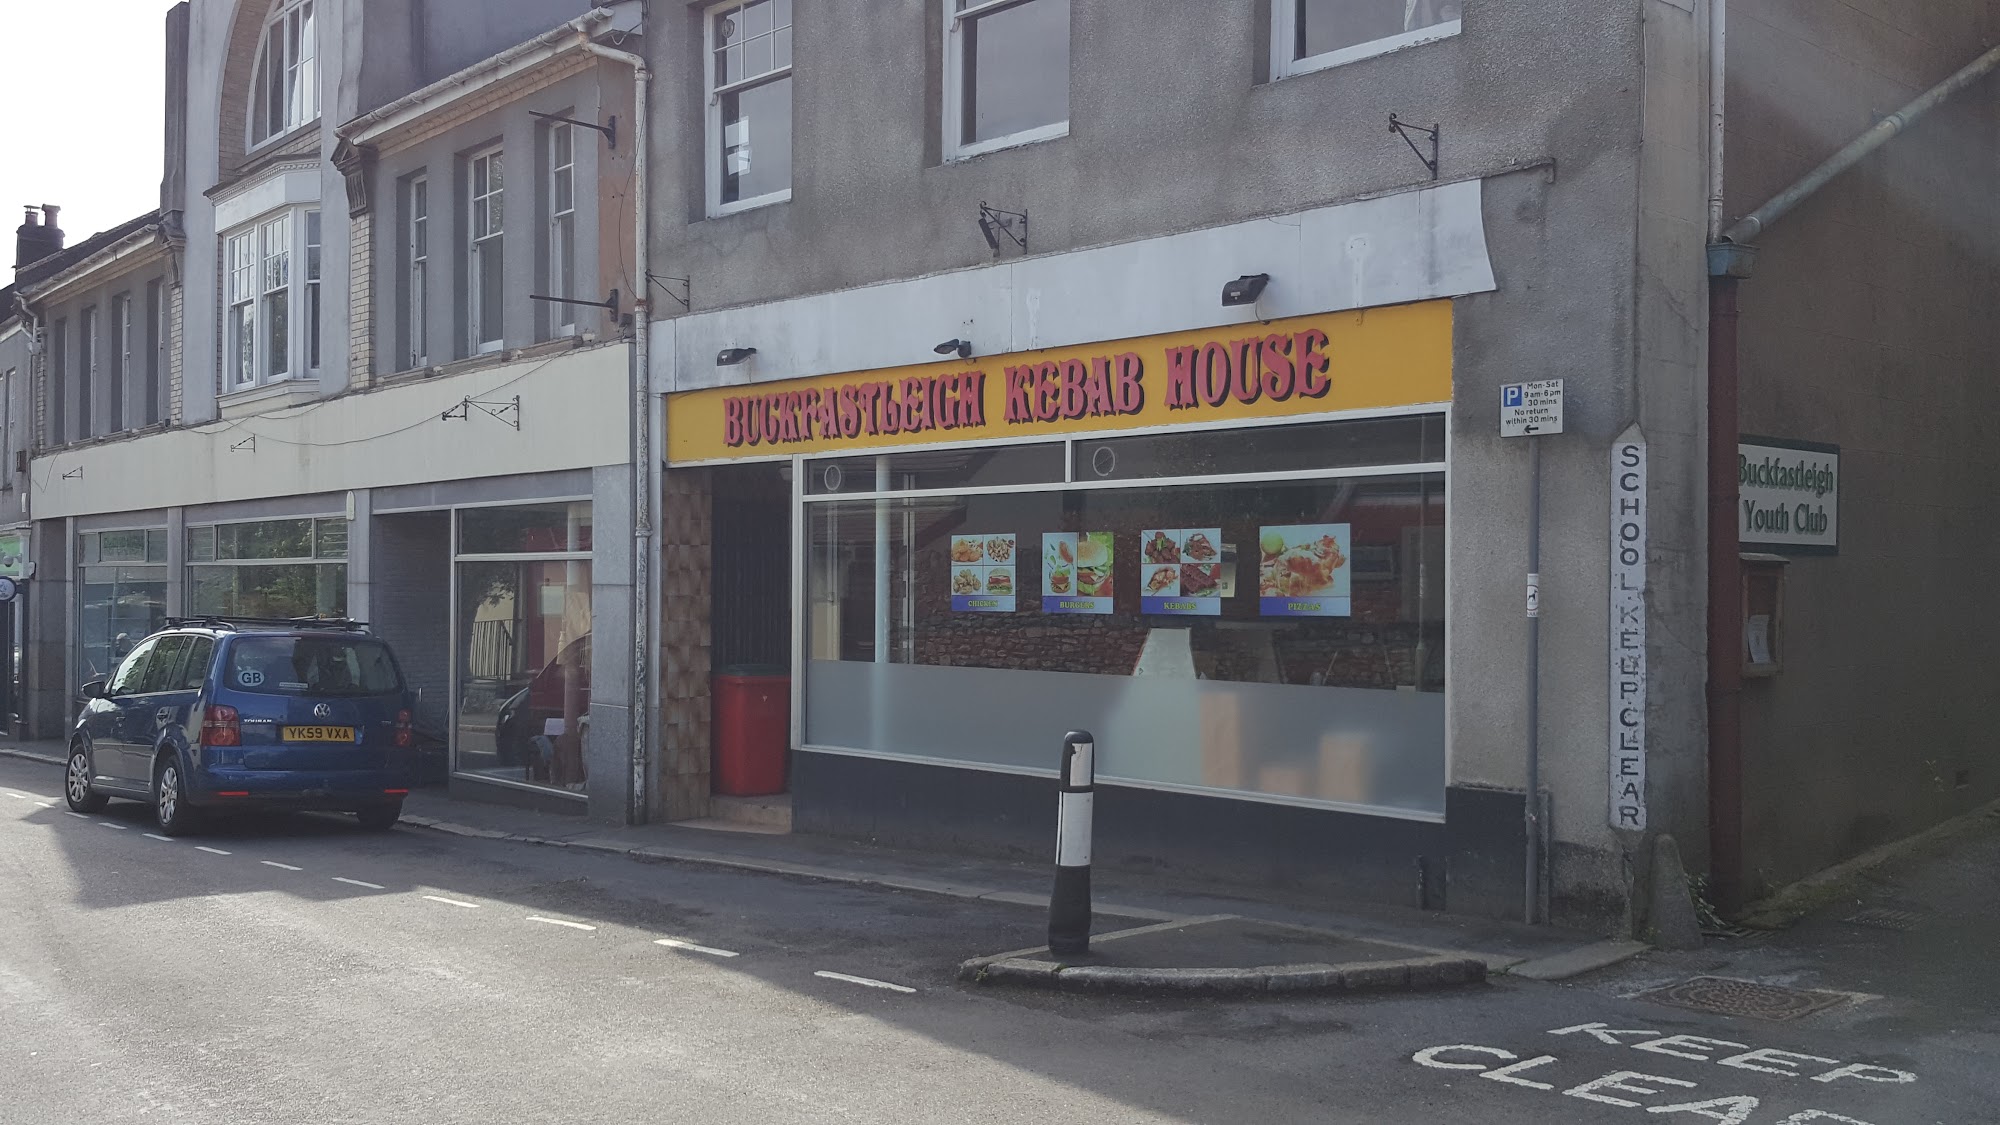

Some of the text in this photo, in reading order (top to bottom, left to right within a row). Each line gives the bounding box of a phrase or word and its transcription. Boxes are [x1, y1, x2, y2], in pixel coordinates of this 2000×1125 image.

[722, 327, 1332, 448] BUCKFASTLEIGH KEBAB HOUSE
[1506, 387, 1518, 406] P
[1528, 398, 1557, 407] 30 mins
[1514, 408, 1549, 416] No return
[1505, 415, 1558, 426] within 30 mins
[1738, 453, 1834, 499] Buckfastleigh
[1619, 444, 1640, 592] SCHOOL
[1742, 499, 1828, 536] Youth Club
[1059, 601, 1096, 609] BURGERS
[1163, 602, 1197, 610] KEBABS
[1287, 602, 1322, 611] PIZZAS
[241, 672, 263, 684] GB
[289, 727, 350, 739] YK59 VXA
[1618, 707, 1640, 826] CLEAR
[1546, 1022, 1918, 1084] KEEP
